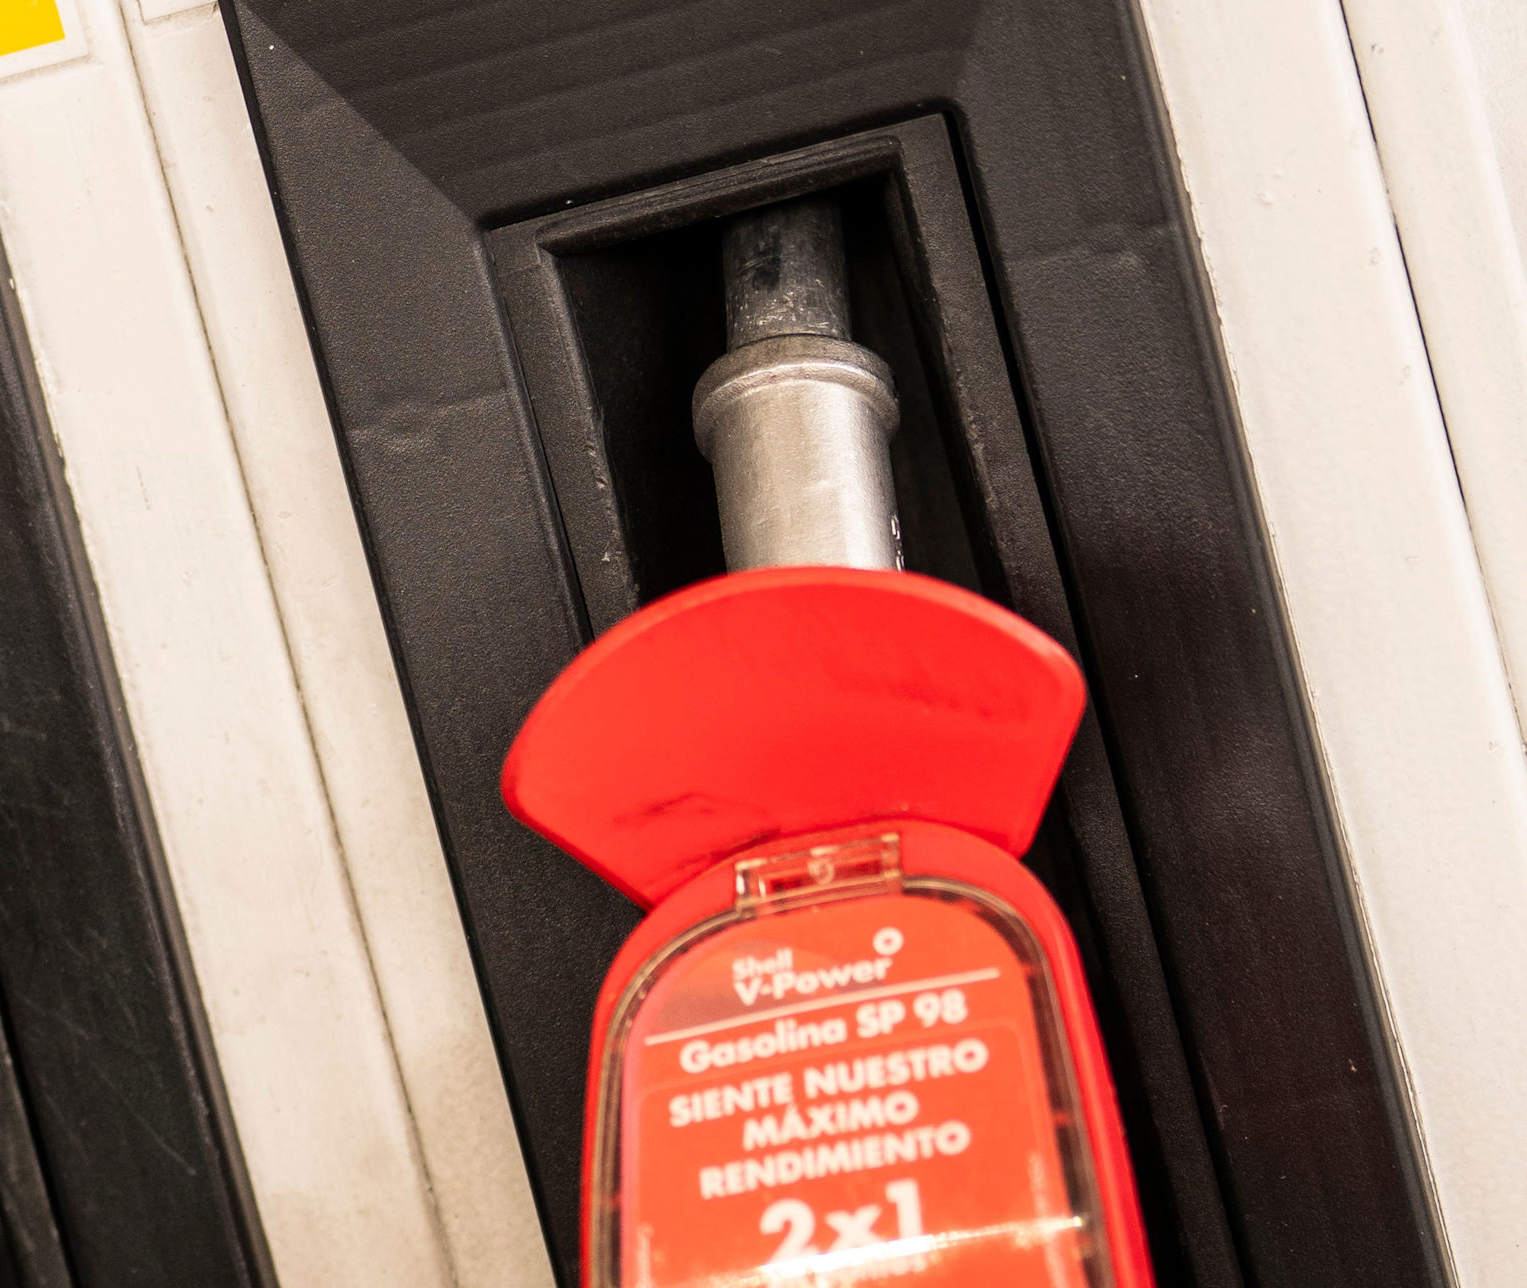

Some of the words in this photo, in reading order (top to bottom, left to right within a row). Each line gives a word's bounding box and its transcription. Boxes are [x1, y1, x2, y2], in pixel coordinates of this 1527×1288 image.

[732, 948, 793, 978] Shell
[733, 955, 893, 1006] V-Power
[679, 1016, 847, 1074] Gasolina
[856, 1000, 906, 1039] SP
[913, 988, 967, 1027] 98
[668, 1073, 794, 1128] SIENTE
[804, 1038, 989, 1099] NUESTRO
[742, 1090, 919, 1151] MÁXIMO
[699, 1121, 972, 1200] RENDIMIENTO
[759, 1178, 924, 1272] 2x1
